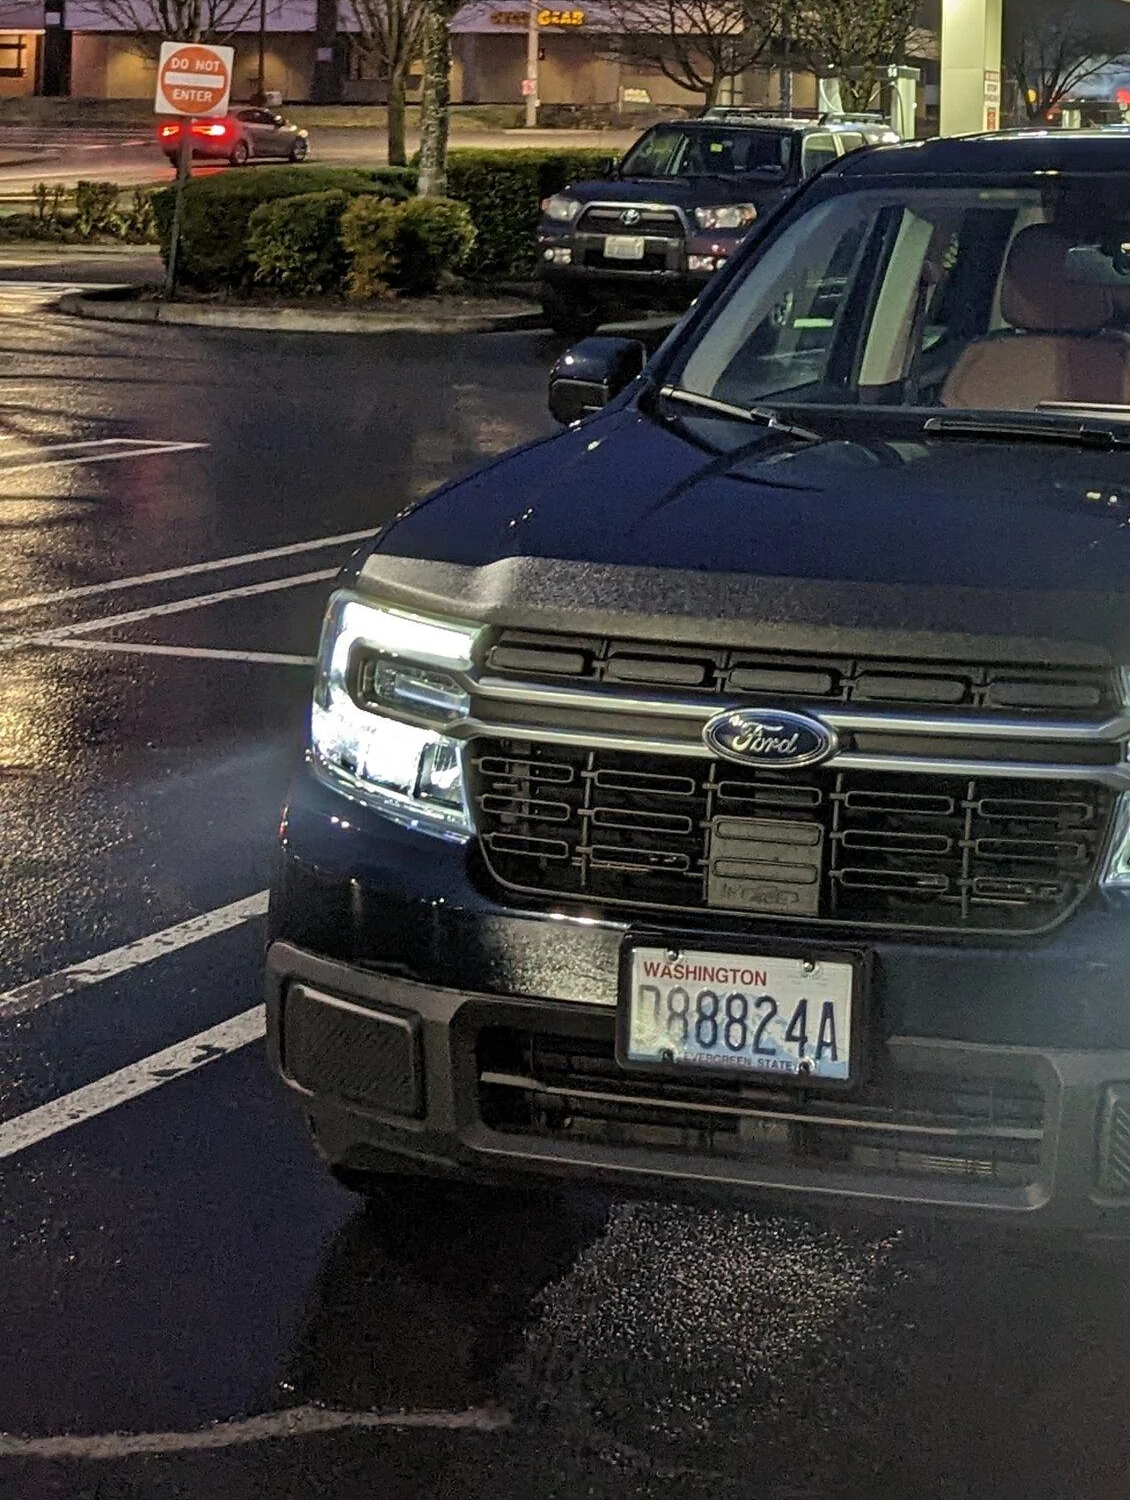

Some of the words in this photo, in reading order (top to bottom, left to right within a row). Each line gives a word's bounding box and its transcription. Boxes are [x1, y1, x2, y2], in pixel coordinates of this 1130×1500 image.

[171, 57, 189, 70] DO
[195, 59, 221, 72] NOT
[172, 88, 213, 102] ENTER
[729, 714, 799, 753] Ford
[644, 961, 767, 986] WASHINGTON
[757, 1058, 793, 1072] STATE
